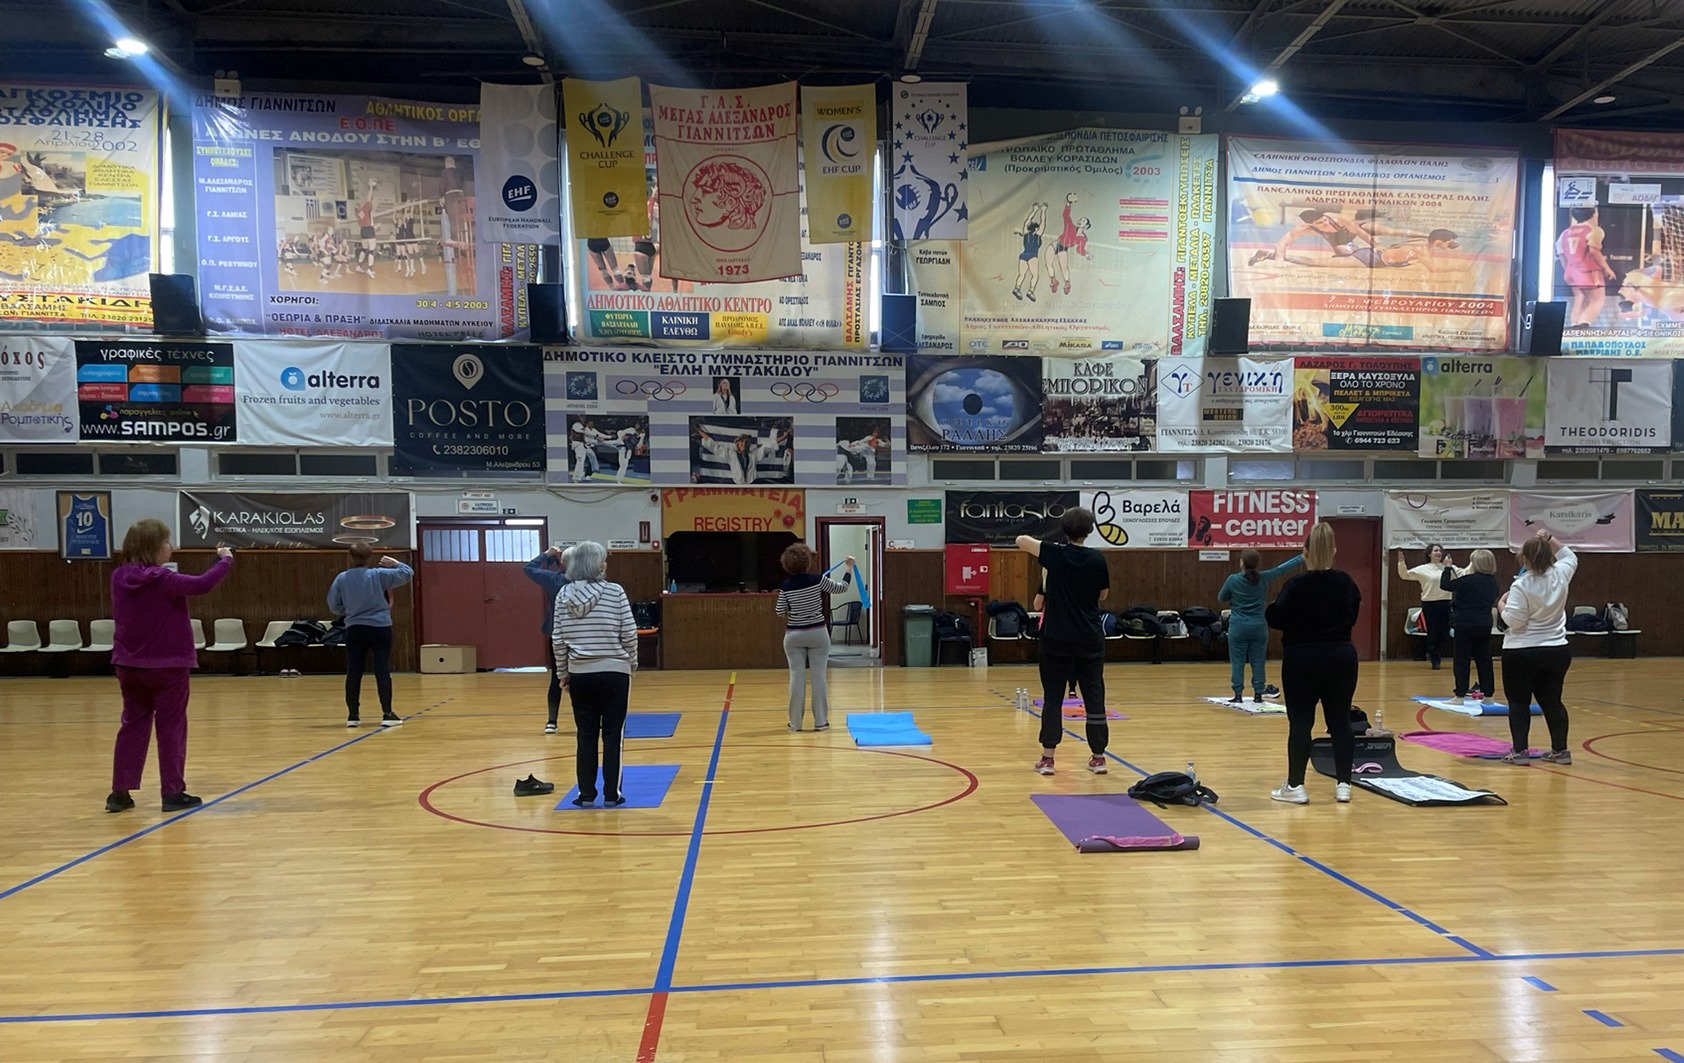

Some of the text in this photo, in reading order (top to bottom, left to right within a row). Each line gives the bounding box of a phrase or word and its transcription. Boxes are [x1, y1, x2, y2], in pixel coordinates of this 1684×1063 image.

[250, 97, 336, 113] ΓΙΑΝΝΙΤΣΩΝ
[365, 101, 444, 121] ΑΘΛΗΤΙΚΟΣ
[817, 105, 862, 115] WOMEN'S
[658, 103, 791, 125] ΜΕΓΑΣ ΑΛΕΞΑΝΔΡΟΣ
[677, 123, 775, 140] ΓΙΑΝΝΙΤΣΩΝ
[1100, 132, 1168, 143] ΠΕΤΟΣΦΑΙΡΙΣΗΣ
[290, 131, 427, 147] ΑΝΟΔΟΥ ΣΤΗΝ
[91, 140, 139, 152] 2002
[1061, 146, 1136, 154] ΠΡΩΤΑΘΛΗΜΑ
[580, 150, 634, 159] CHALLENGE
[1010, 155, 1118, 163] ΒΟΛΛΕΥ ΚΟΡΑΣΙΔΩΝ
[1254, 153, 1300, 161] ΕΛΛΗΝΙΚΗ
[1303, 155, 1364, 164] ΟΜΟΣΠΟΝΔΙΑ
[598, 160, 617, 168] CUP
[823, 165, 861, 174] EHF CUP
[1004, 164, 1081, 174] (Προκριματικός
[1133, 167, 1160, 176] 2003
[1252, 166, 1282, 174] ΔΗΜΟΣ
[1285, 168, 1336, 176] ΓΙΑΝΝΙΤΣΩΝ
[508, 185, 531, 199] EHF
[1203, 158, 1214, 222] ΓΙΑΝΝΙΤΣΑ
[1257, 186, 1322, 196] ΠΑΝΕΛΛΗΝΙΟ
[1325, 189, 1394, 199] ΠΡΩΤΑΘΛΗΜΑ
[1397, 192, 1454, 201] ΕΛΕΥΘΕΡΑΣ
[1305, 196, 1346, 204] ΑΝΔΡΩΝ
[1171, 137, 1190, 355] ΒΑΛΣΑΜΗΣ: ΓΙΓΑΝΤΟΕΚΤΥΠΩΣΕΙΣ
[1186, 156, 1201, 339] ΚΥΠΕΛΑ ΜΕΤΑΛΛΙΑ ΠΛΑΚΕΤΕΣ
[916, 257, 950, 265] ΓΕΩΡΓΙΑΔΗ
[717, 264, 750, 276] 1973
[270, 295, 319, 305] ΧΟΡΗΓΟΙ:
[587, 294, 772, 313] ΔΗΜΟΤΙΚΟ ΑΘΛΗΤΙΚΟ ΚΕΝΤΡΟ
[1459, 300, 1494, 309] 2004
[1, 303, 67, 311] ΒΑΛΣΑΜΗΣ
[21, 310, 66, 318] ΓΙΑΝΝΙΤΣΑ
[413, 319, 460, 327] ΜΑΘΗΜΑΤΩΝ
[661, 316, 698, 325] ΚΛΙΝΙΚΗ
[663, 327, 698, 336] ΕΛΕΥΘΩ
[1571, 341, 1646, 349] ΠΑΠΑΔΟΠΟΥΛΟΣ
[100, 346, 215, 363] γραφικές τέχνες
[543, 351, 903, 367] ΔΗΜΟΤΙΚΟ ΚΛΕΙΣΤΟ ΓΥΜΝΑΣΤΗΡΙΟ ΓΙΑΝΝΙΤΣΩΝ
[653, 364, 819, 377] "ΕΛΛΗ ΜΥΣΤΑΚΙΔΟΥ"
[1074, 362, 1114, 377] ΚΑΦΕ
[1300, 361, 1345, 369] ΛΑΖΑΡΟΣ
[1361, 362, 1413, 370] ΤΟΛΟΥΠΗΣ
[1441, 359, 1493, 373] alterra
[307, 370, 380, 389] alterra
[1331, 372, 1415, 381] ΞΕΡΑ ΚΑΥΣΟΞΥΛΑ
[1042, 378, 1148, 395] ΕΜΠΟΡΙΚΟΝ
[1339, 380, 1359, 388] ΟΛΟ
[1375, 381, 1406, 389] ΧΡΟΝΟ
[242, 394, 381, 408] Frozen fruits and vegetables
[320, 411, 381, 420] www.alterra.gr
[407, 398, 531, 428] POSTO
[81, 420, 231, 440] www.SAMPOS.gr
[942, 429, 1007, 440] ΡΑΛΛΗΣ
[1560, 427, 1656, 438] THEODORIDIS
[443, 444, 510, 456] 2382306010
[1123, 499, 1181, 516] Βαρελά
[1213, 490, 1310, 514] FITNESS
[76, 511, 93, 526] 10
[213, 512, 325, 525] KARAKIOLAS
[1549, 510, 1592, 519] Katsikaris
[694, 516, 772, 531] REGISTRY
[1226, 518, 1309, 536] center
